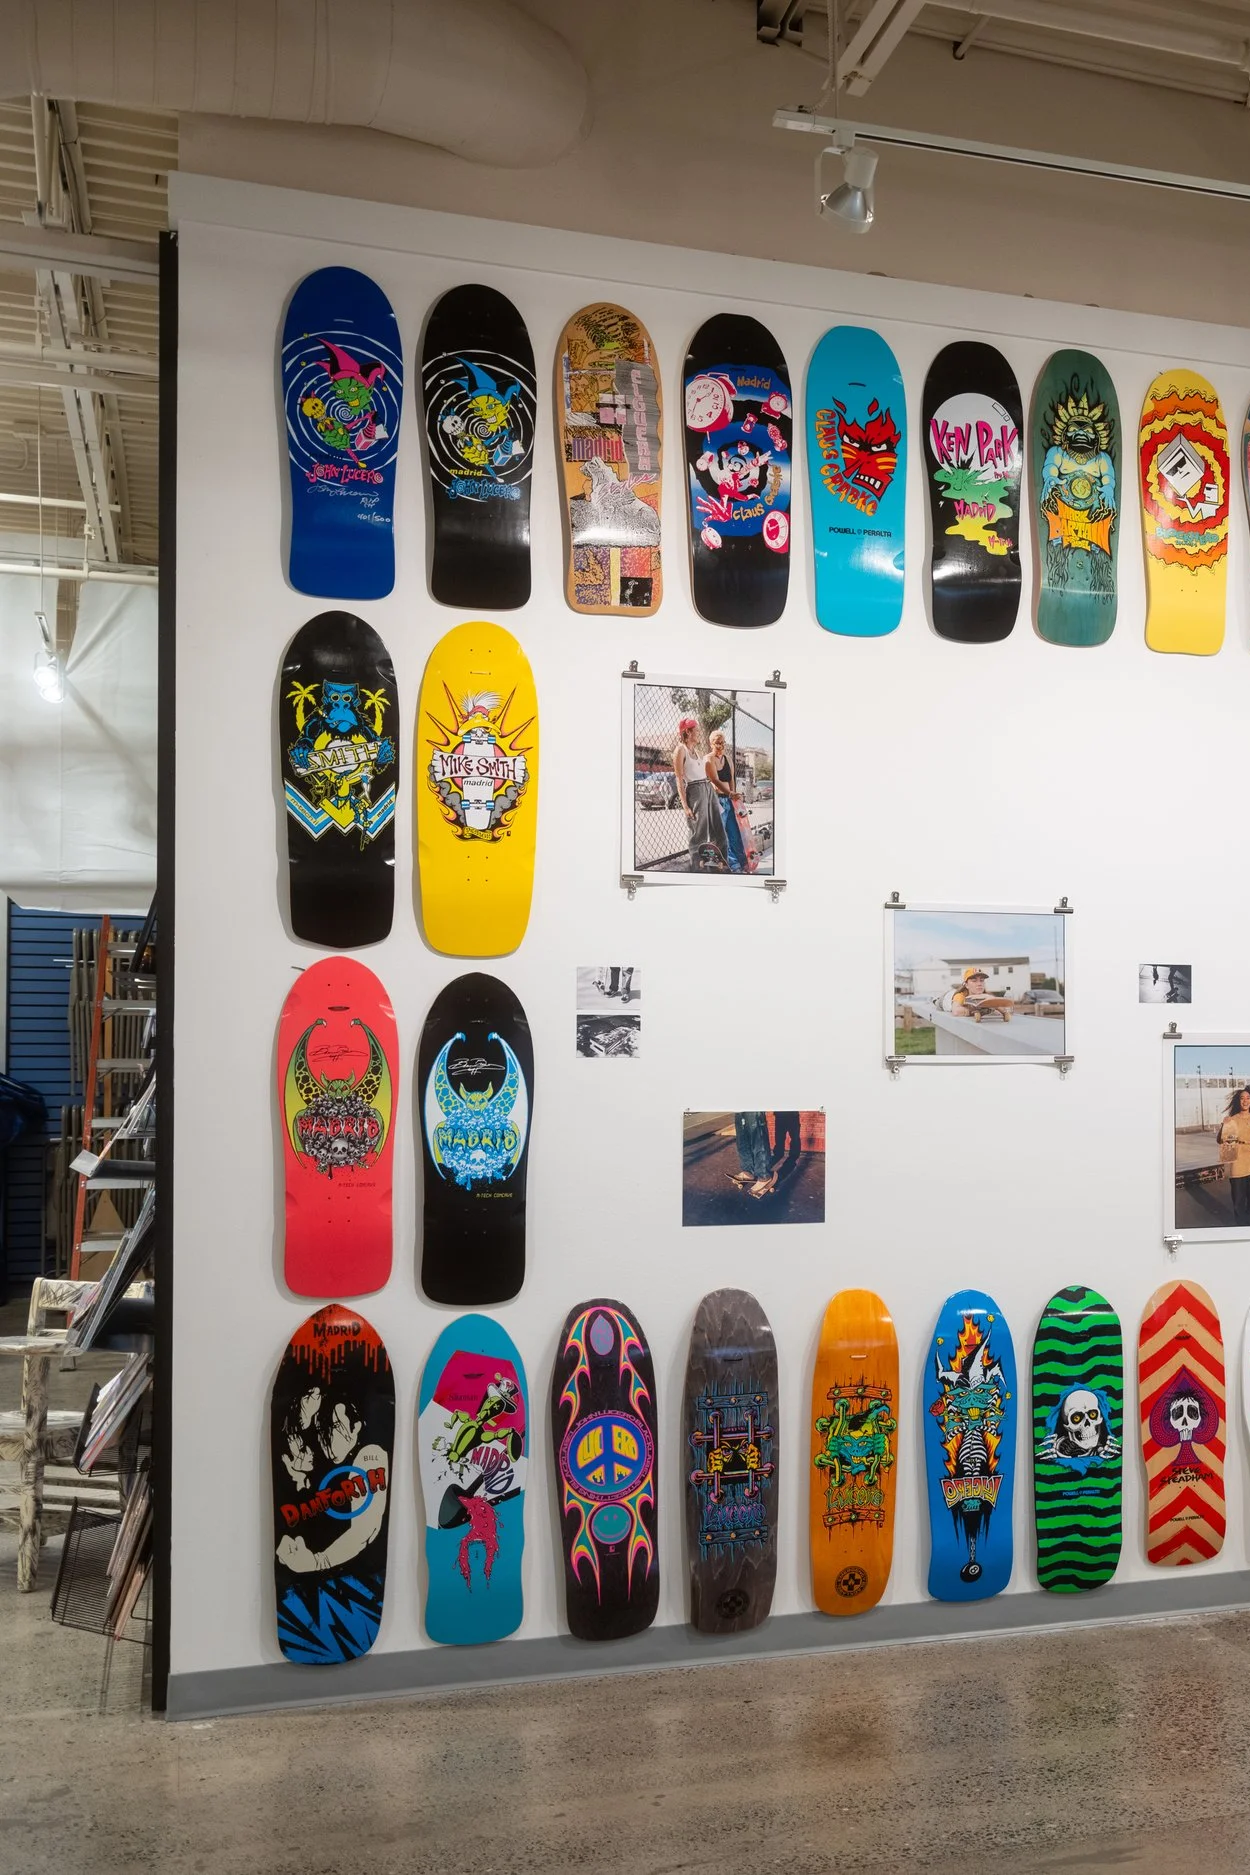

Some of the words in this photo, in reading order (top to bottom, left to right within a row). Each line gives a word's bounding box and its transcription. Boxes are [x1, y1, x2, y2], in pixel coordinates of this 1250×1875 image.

[737, 376, 771, 390] Madrid
[816, 408, 839, 460] CLAUS
[930, 418, 971, 464] KEN
[976, 420, 1018, 469] PARK
[573, 435, 623, 461] madrid
[306, 462, 339, 483] JOHN
[340, 465, 384, 484] LUCERO
[449, 469, 483, 477] madrid
[446, 478, 480, 499] JOHN
[479, 479, 520, 500] LUCERO
[820, 463, 878, 517] GRABKE
[829, 527, 856, 535] POWELL
[863, 530, 892, 538] PERALTA
[307, 743, 379, 770] SMITH
[439, 755, 473, 776] MIKE
[476, 757, 517, 779] SMITH
[377, 799, 393, 818] madrid
[298, 1115, 379, 1140] MADRID
[438, 1127, 518, 1151] MADRID
[313, 1321, 361, 1338] MADRID
[363, 1454, 379, 1462] BILL
[1161, 1472, 1213, 1484] STEADHAM
[1172, 1467, 1200, 1475] STEVE
[280, 1467, 387, 1528] DANFORTH
